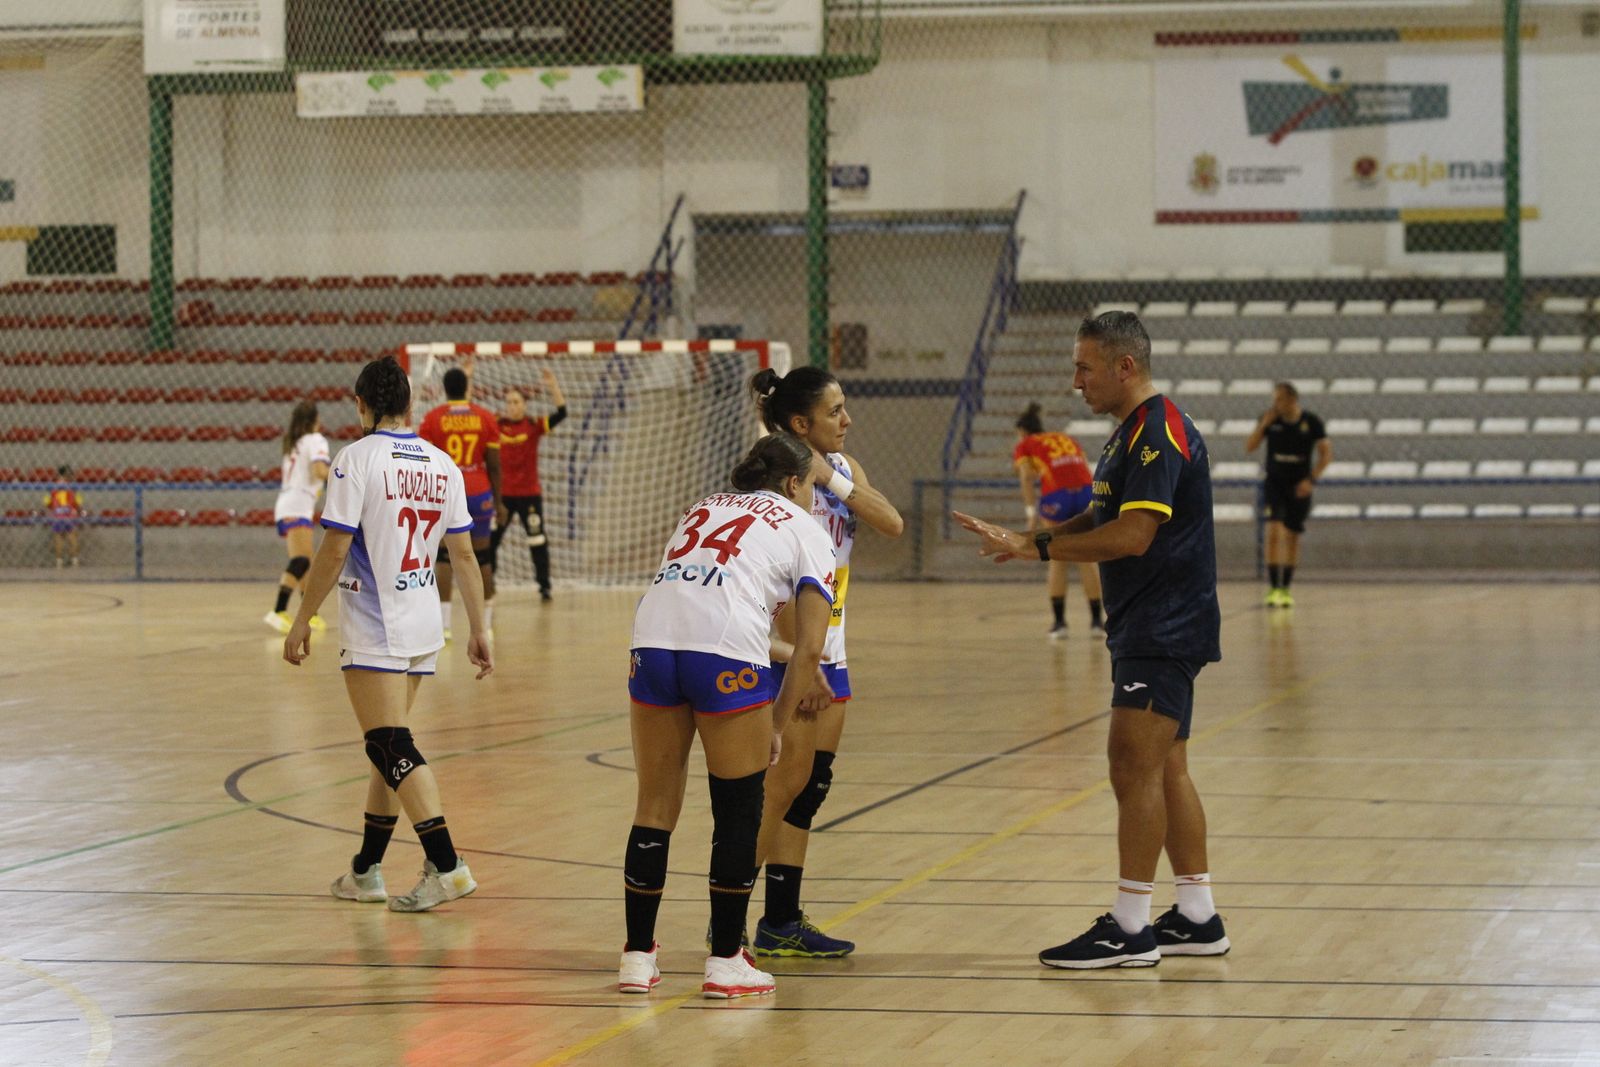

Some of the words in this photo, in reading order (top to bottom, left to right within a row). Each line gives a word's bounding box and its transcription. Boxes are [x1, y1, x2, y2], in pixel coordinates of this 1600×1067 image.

[176, 10, 261, 23] DEPORTES
[447, 434, 479, 465] 97
[397, 506, 441, 573] 27
[666, 507, 757, 565] 34
[828, 513, 845, 548] 10
[716, 667, 759, 694] GO
